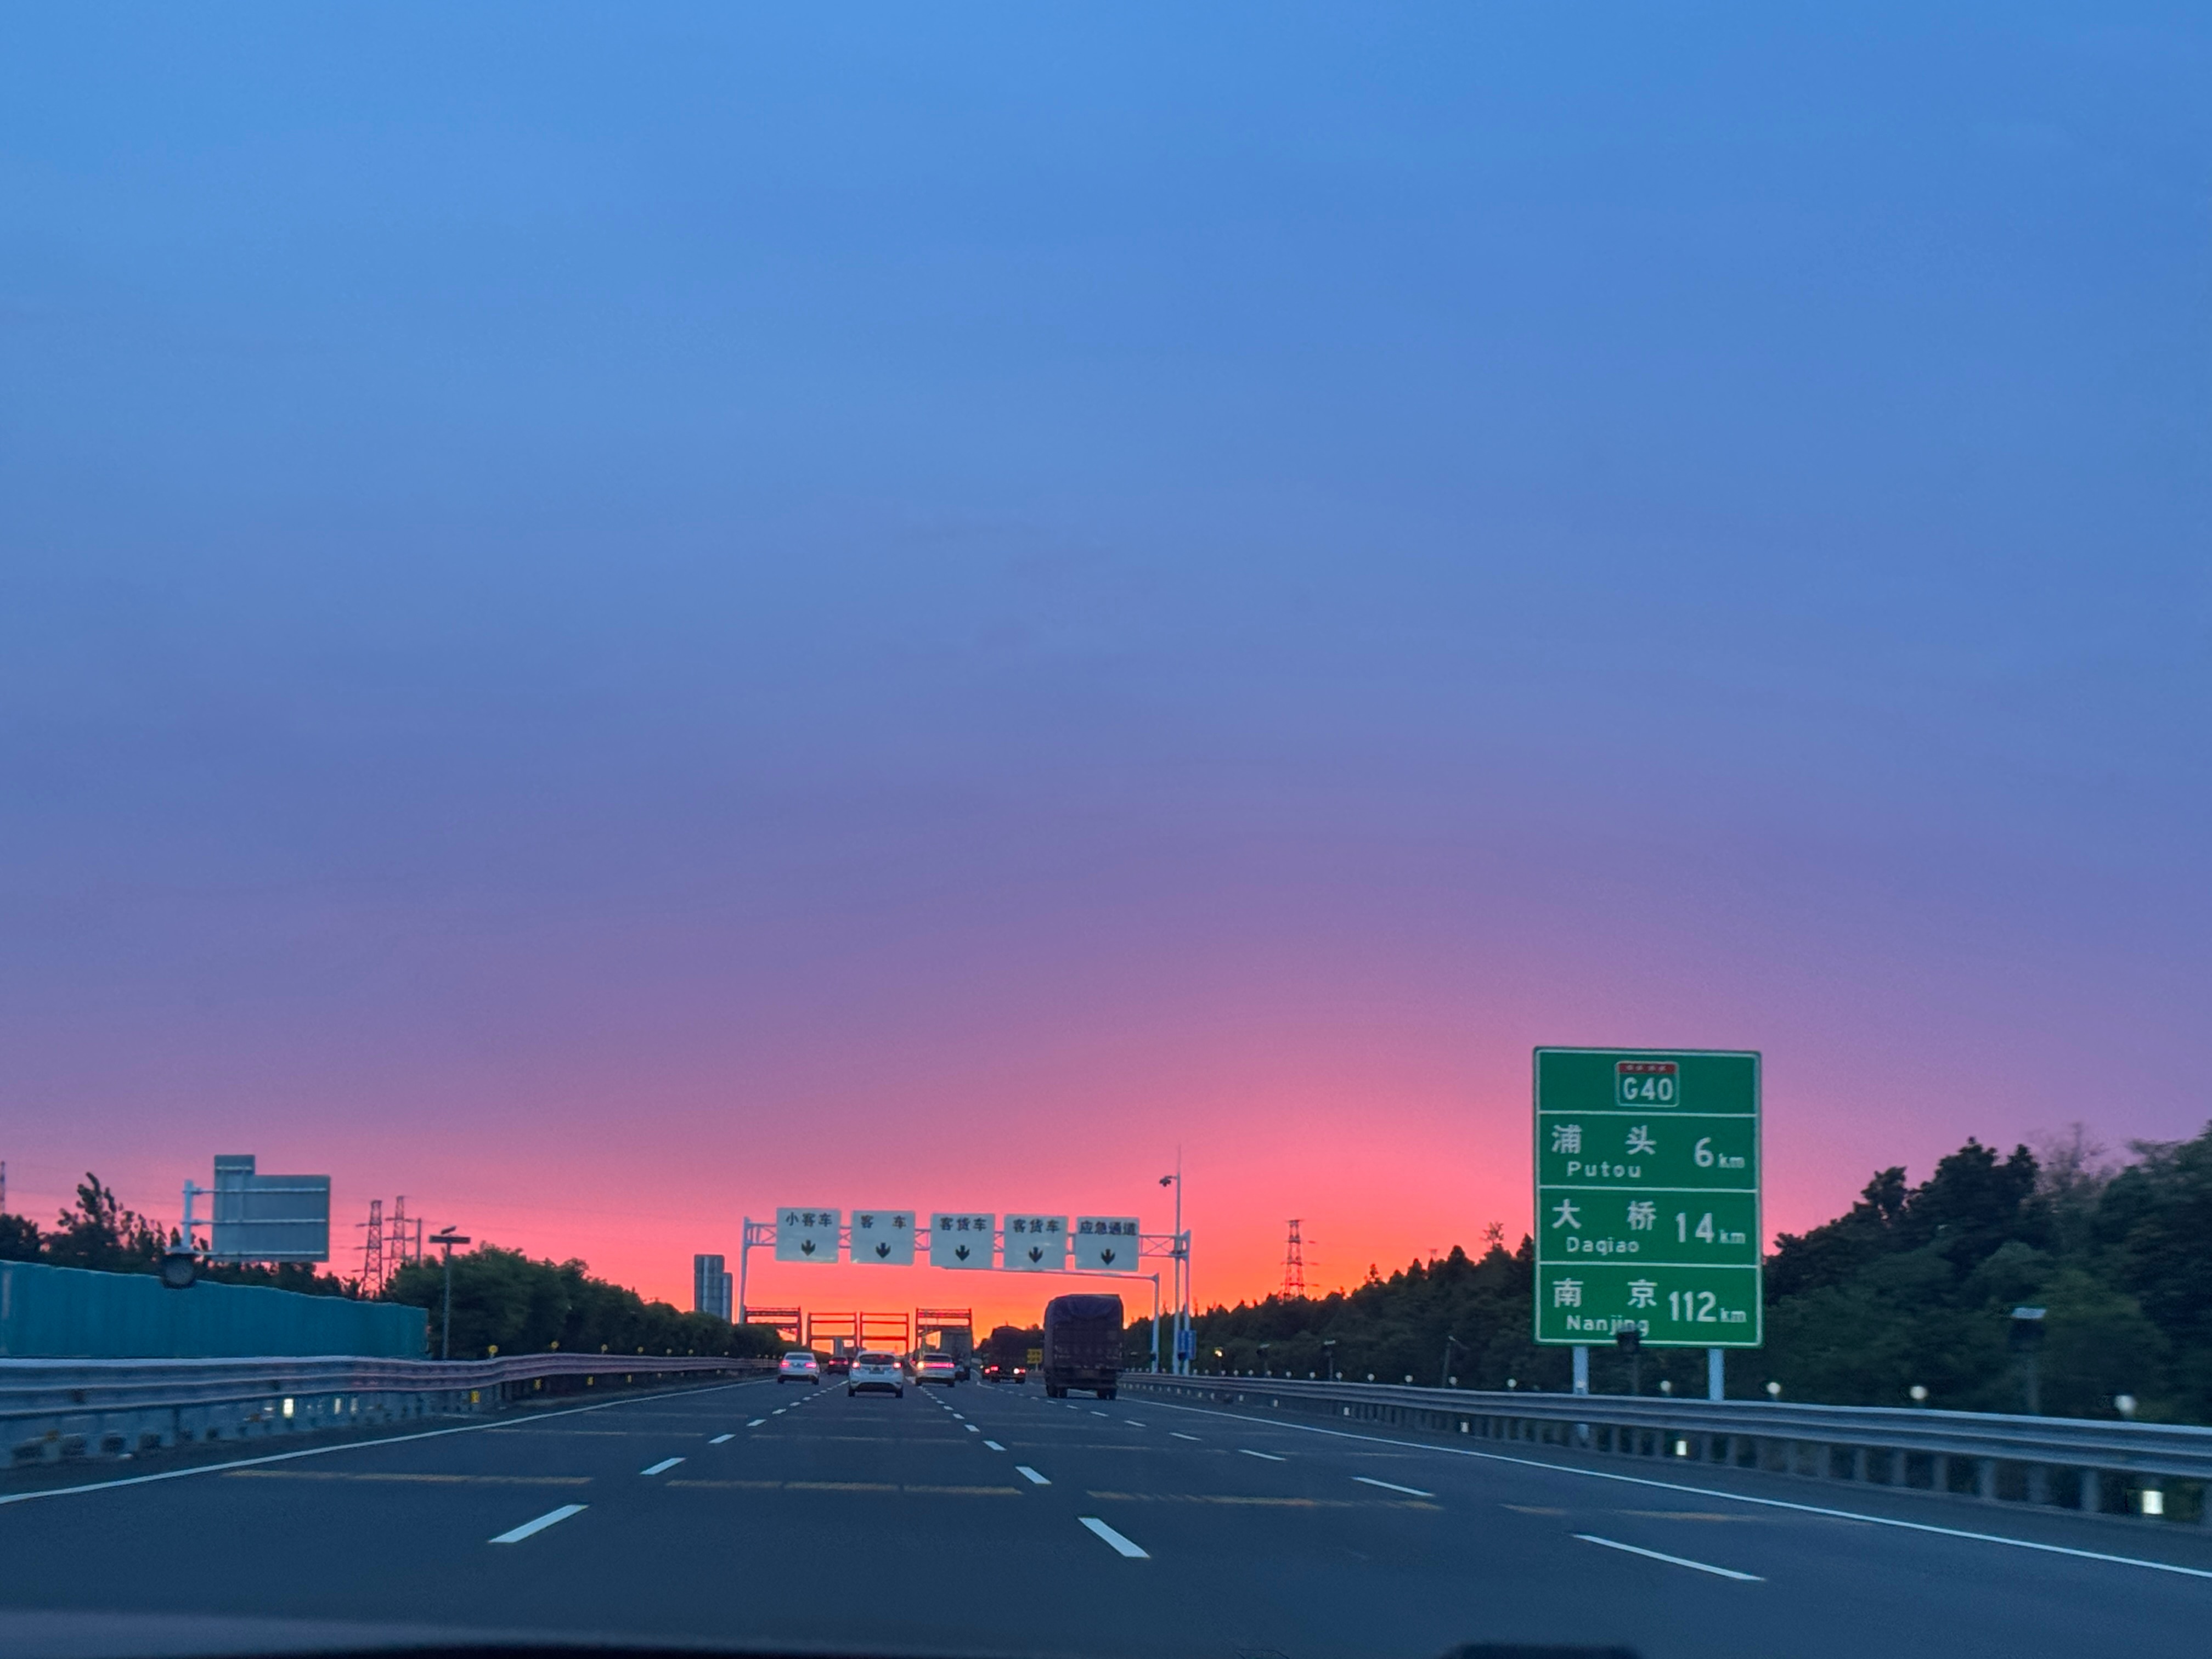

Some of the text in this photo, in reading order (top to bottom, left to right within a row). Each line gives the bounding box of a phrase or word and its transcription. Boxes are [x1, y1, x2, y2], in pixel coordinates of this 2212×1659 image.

[1623, 1077, 1673, 1101] G40
[1694, 1137, 1746, 1168] 6 km
[1567, 1161, 1641, 1178] Putou
[786, 1212, 833, 1228] 小客车
[940, 1217, 986, 1232] 客货车
[1013, 1218, 1060, 1234] 客货车
[1551, 1198, 1657, 1231] 大桥
[1675, 1212, 1746, 1244] 14 km
[1566, 1236, 1640, 1255] Daqiao
[1552, 1277, 1658, 1308] 南京
[1669, 1291, 1747, 1323] 112 km
